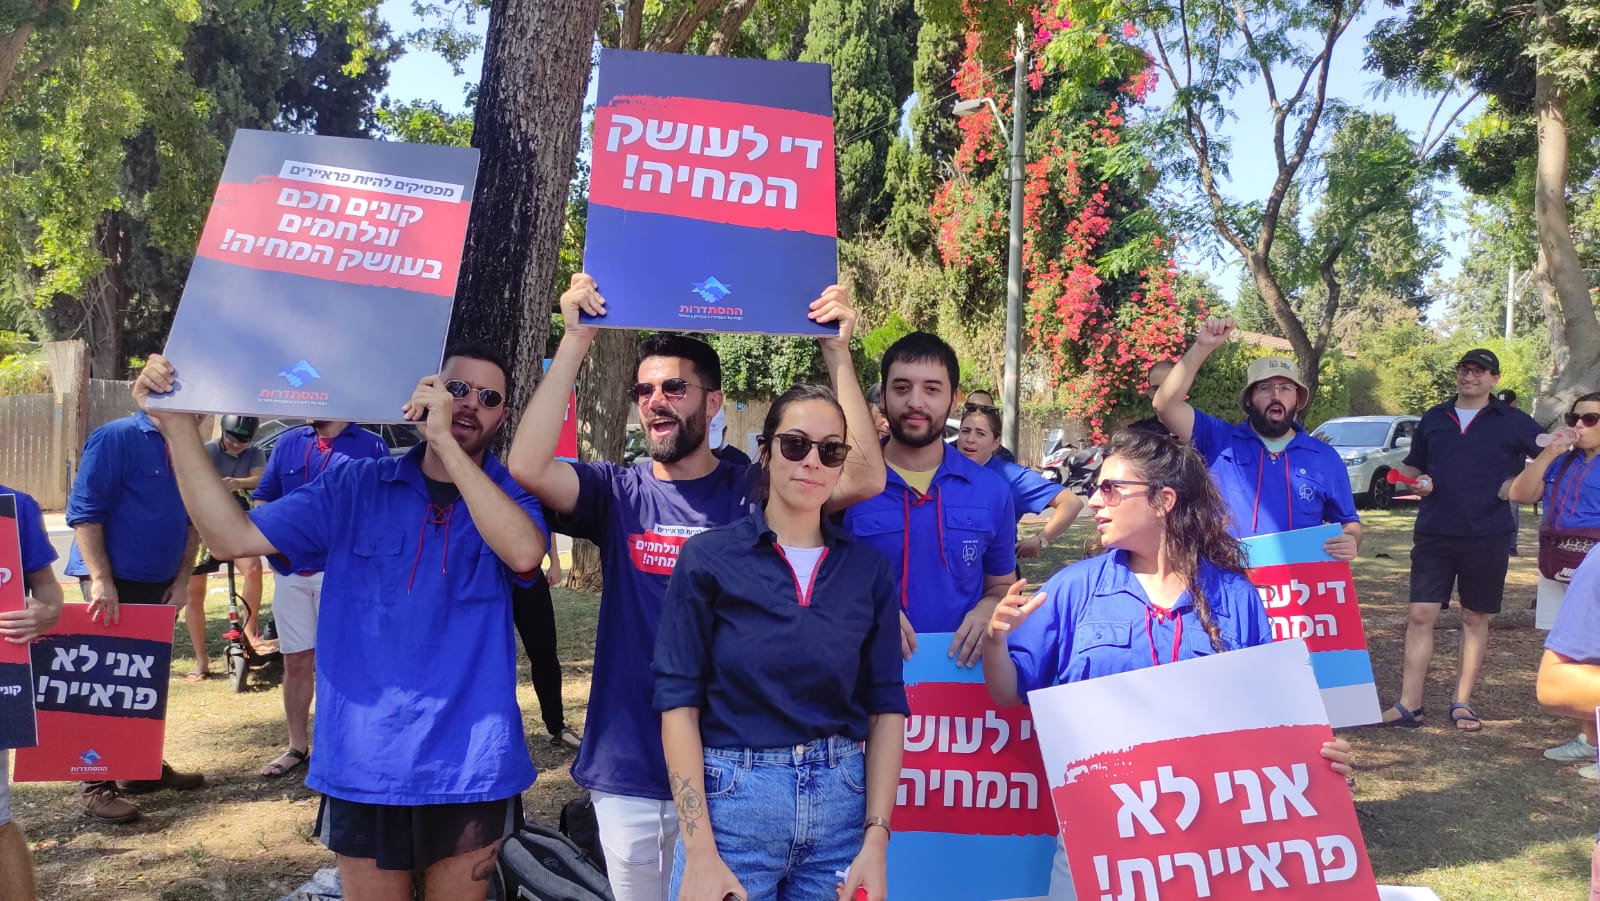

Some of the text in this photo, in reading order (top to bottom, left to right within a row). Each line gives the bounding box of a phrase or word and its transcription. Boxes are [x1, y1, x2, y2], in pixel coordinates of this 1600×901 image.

[606, 113, 823, 169] די לעושק
[289, 165, 455, 198] מפסיקים להיות פראיירים
[622, 153, 798, 210] המחיה!
[277, 187, 424, 227] קונים חכם
[277, 213, 400, 247] ונלחמים
[219, 228, 443, 280] בעושק המחיה!
[679, 304, 743, 316] ההסתדרות
[259, 388, 329, 401] ההסתדרות
[635, 539, 680, 555] ונלחמים
[642, 553, 677, 568] מחיה!
[1257, 579, 1346, 609] די לעו
[1268, 613, 1338, 640] המח
[51, 644, 155, 679] אני לא
[0, 684, 22, 697] קוני
[36, 675, 158, 711] פראייר!
[903, 709, 1031, 755] י לעוש
[1109, 762, 1319, 838] אני לא
[1092, 834, 1359, 901] פראיירית!
